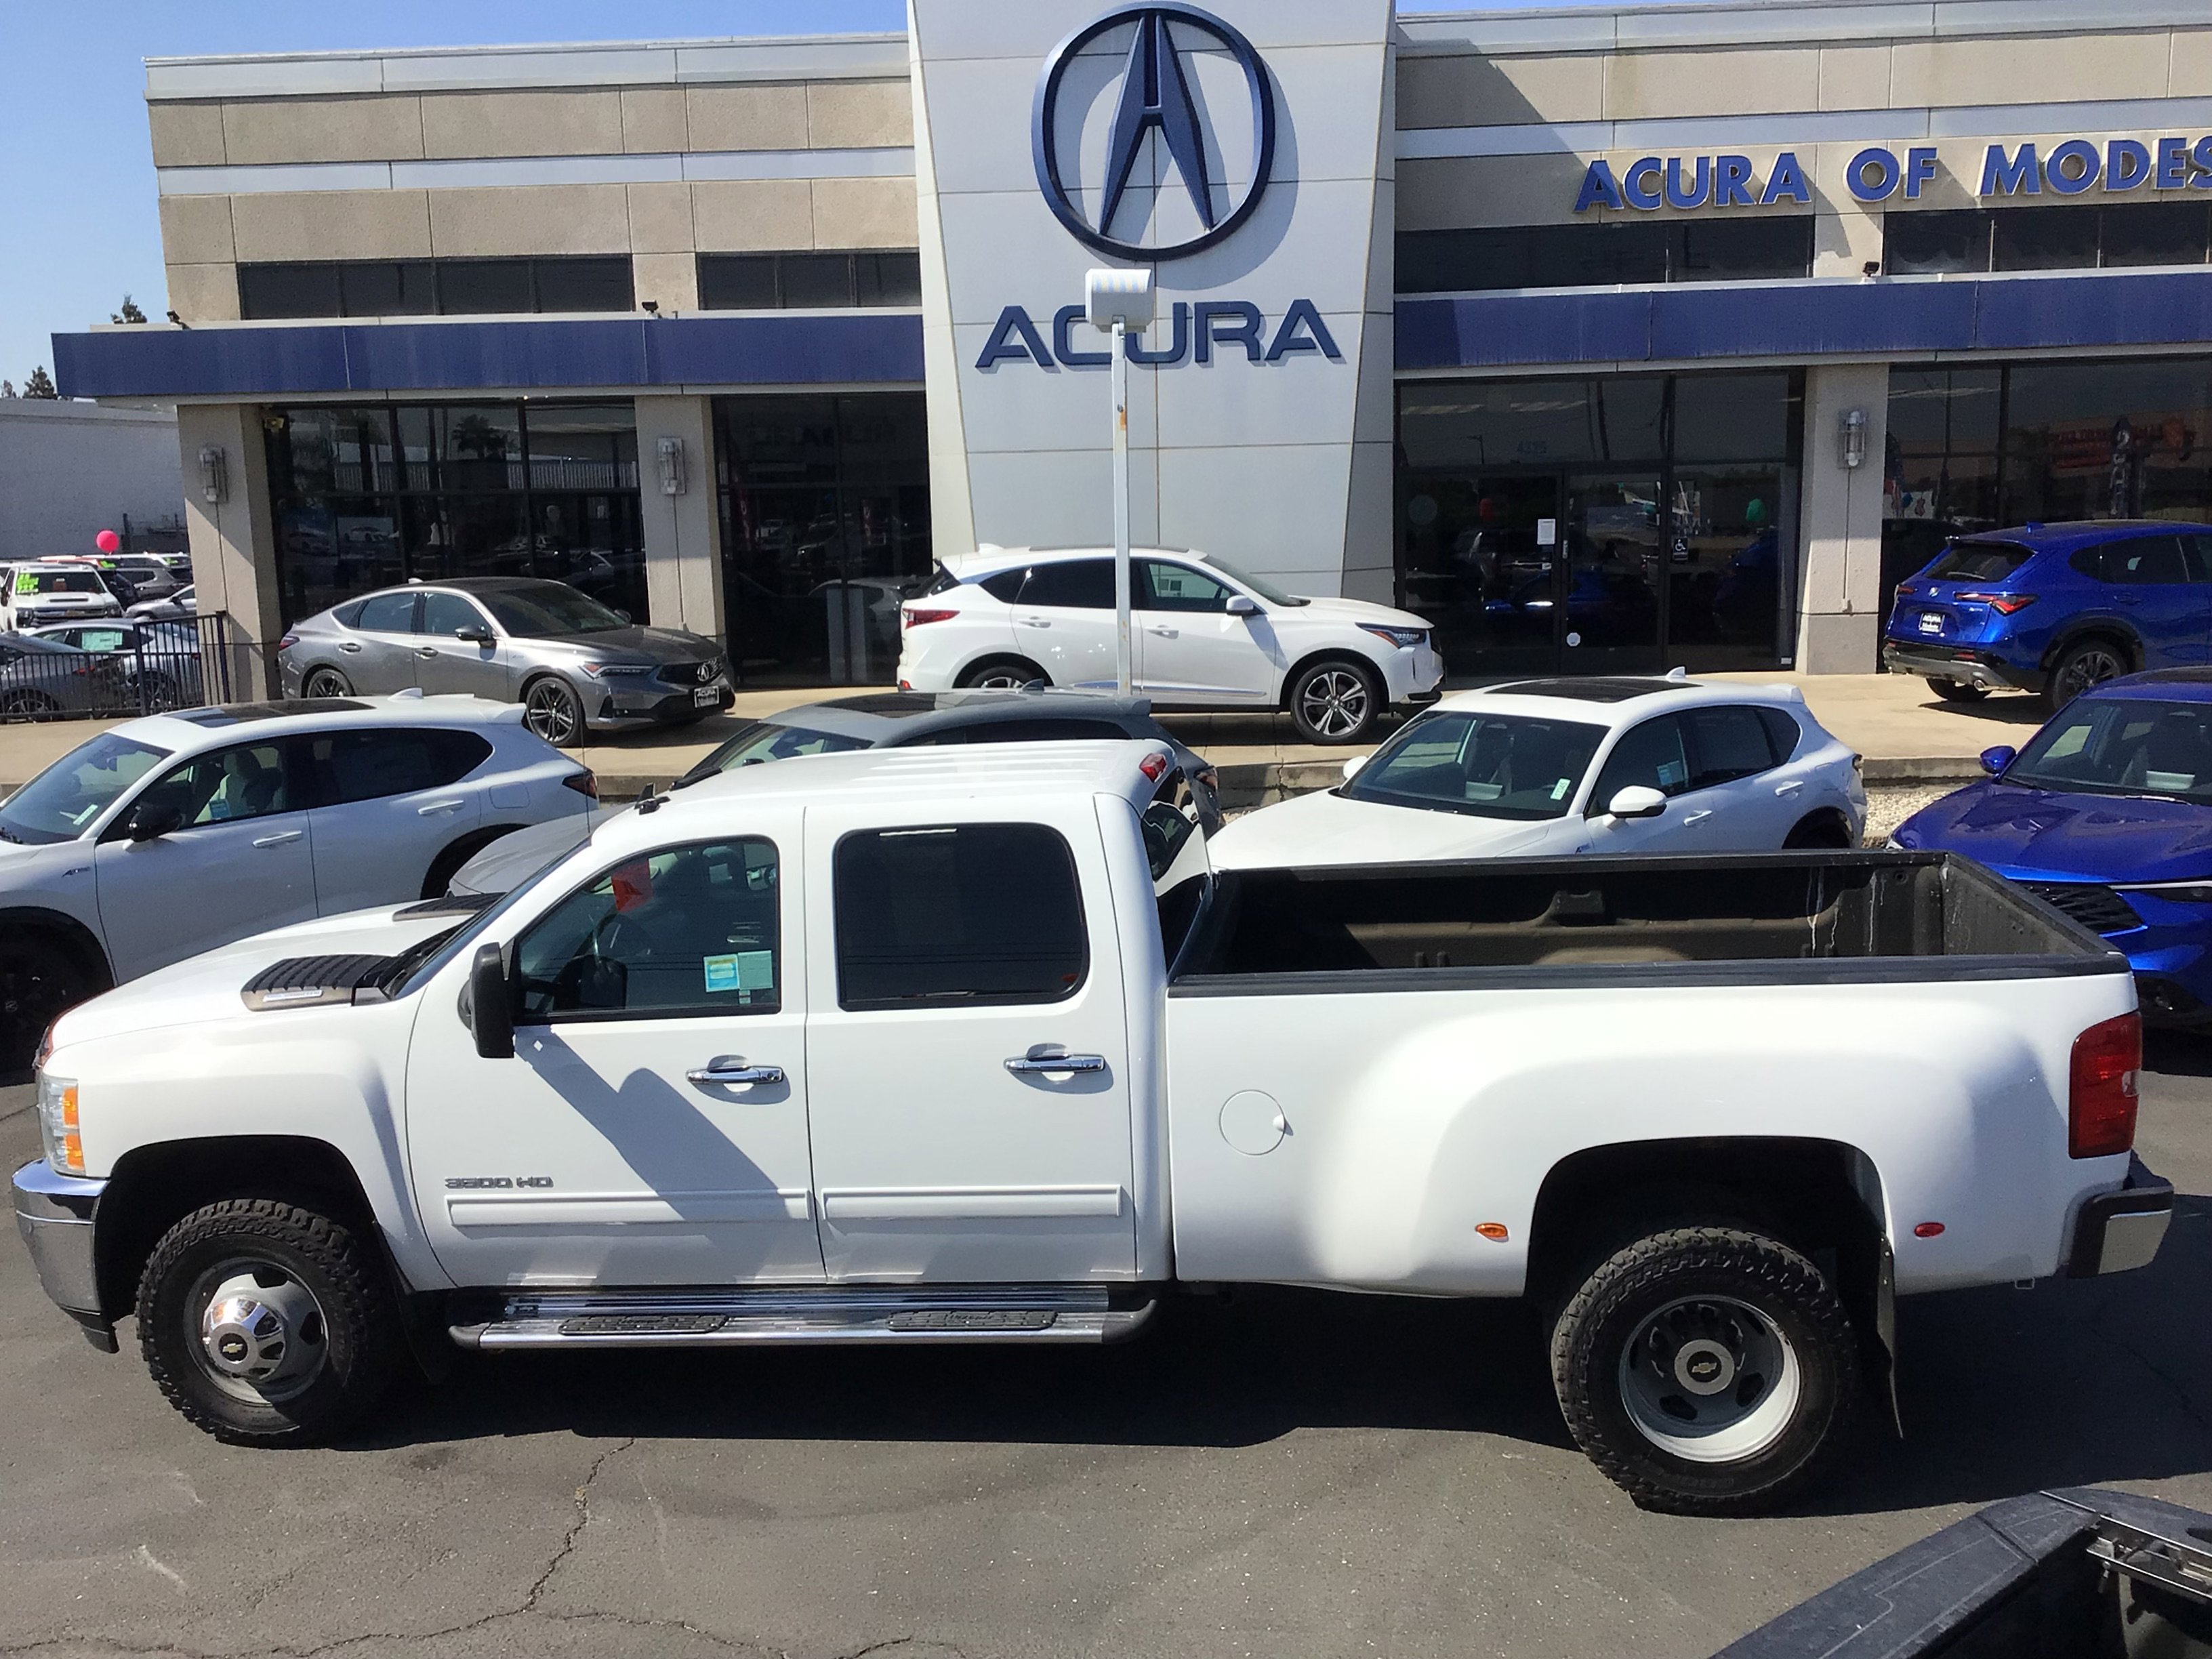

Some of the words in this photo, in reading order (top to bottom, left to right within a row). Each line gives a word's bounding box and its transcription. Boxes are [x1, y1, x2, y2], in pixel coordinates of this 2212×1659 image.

[1573, 152, 1812, 213] ACURA
[1842, 147, 1938, 203] OF
[1975, 136, 2212, 197] MODES
[975, 298, 1342, 369] ACURA
[445, 1176, 514, 1189] 3500
[516, 1176, 554, 1188] HD
